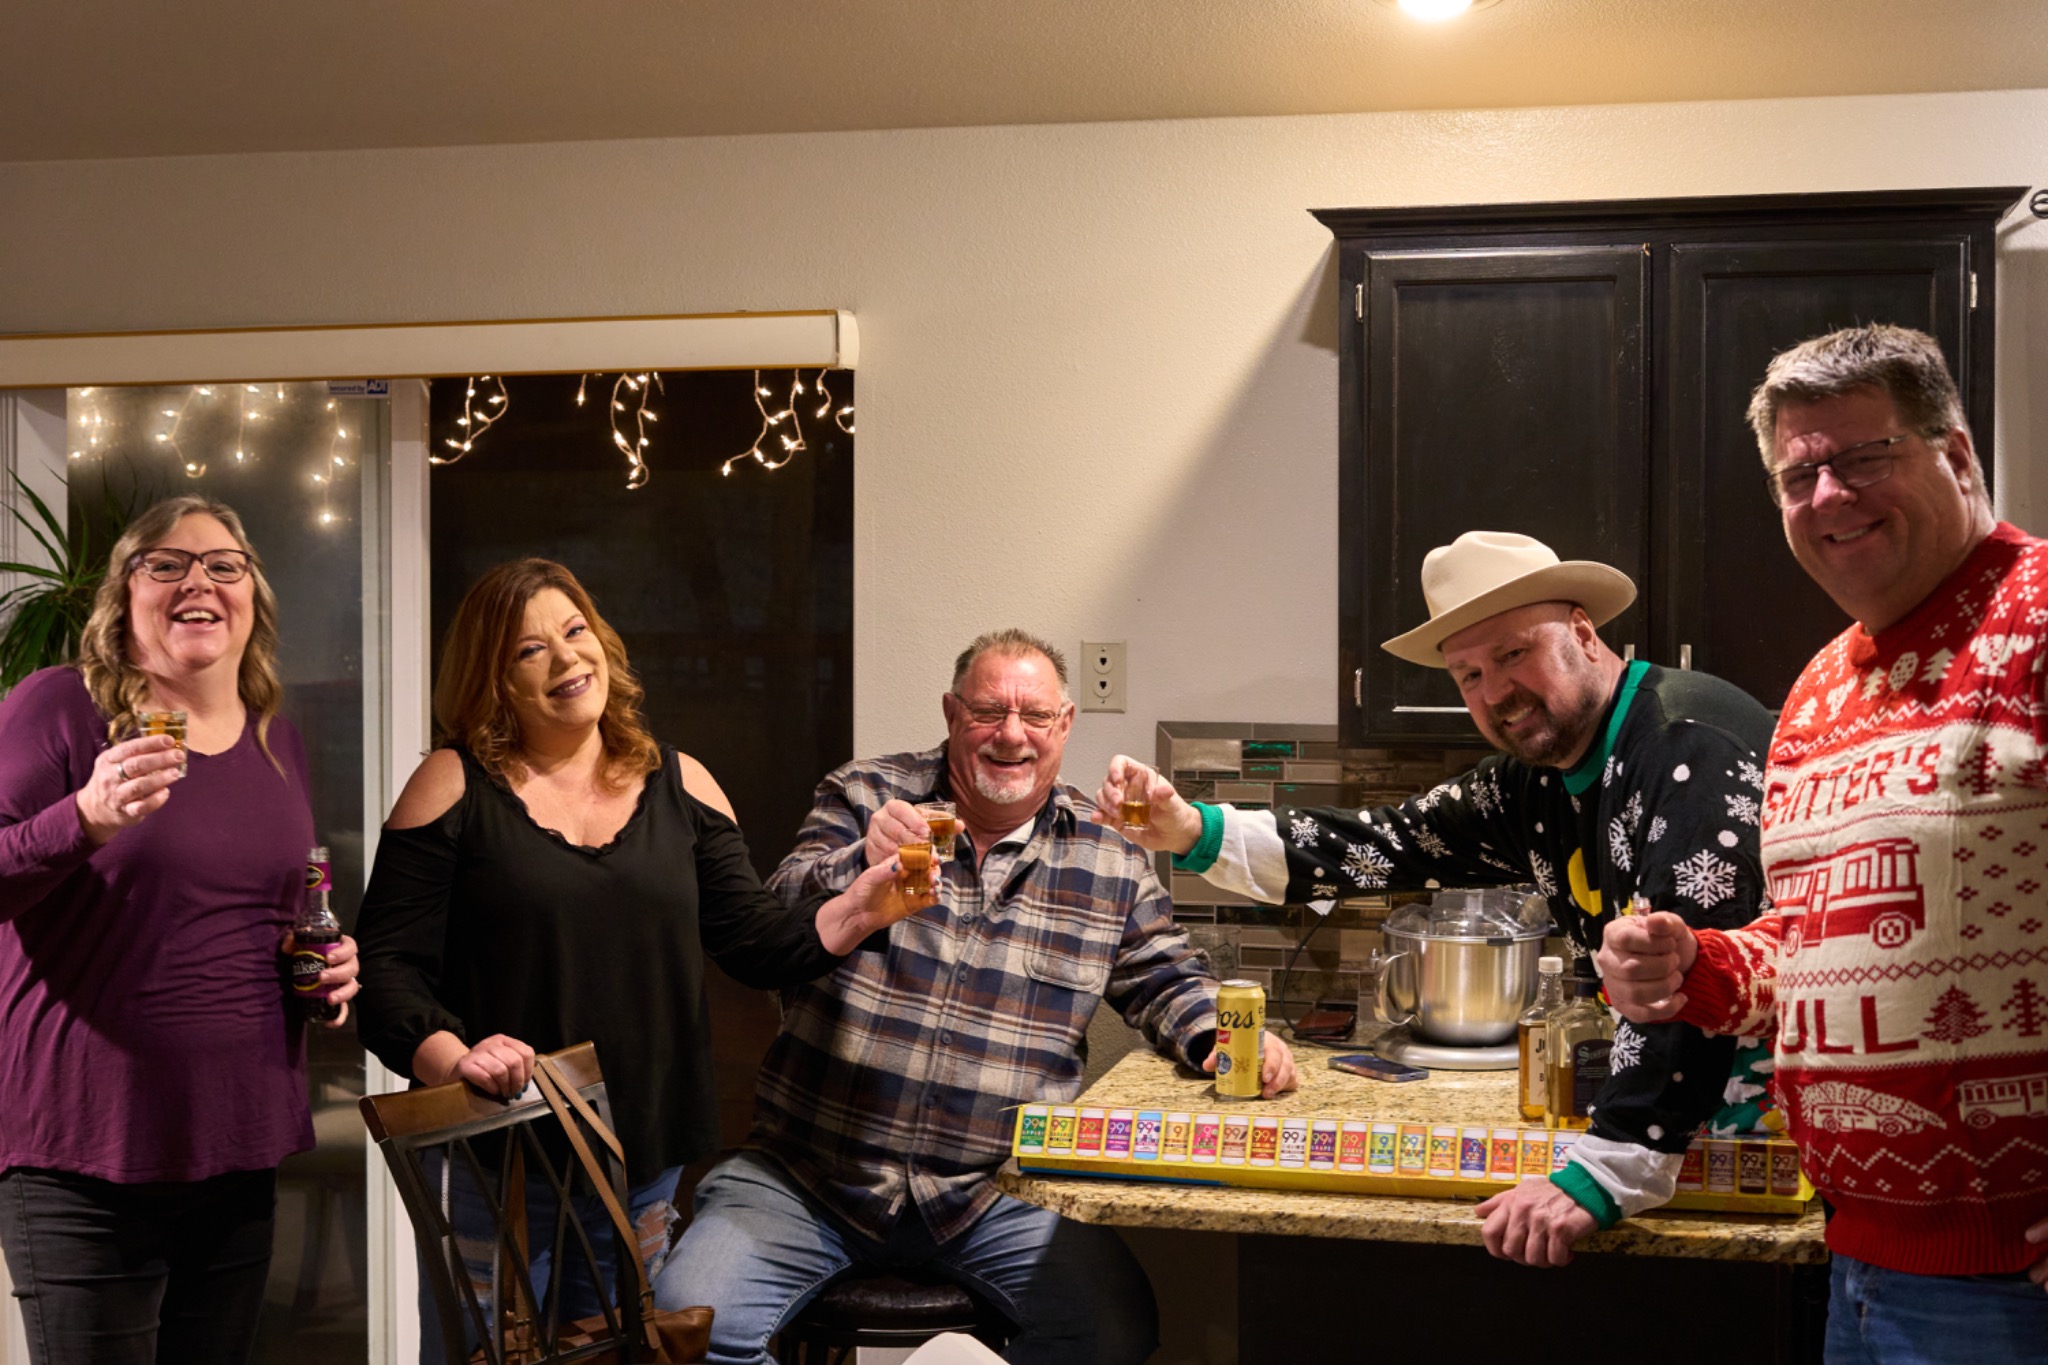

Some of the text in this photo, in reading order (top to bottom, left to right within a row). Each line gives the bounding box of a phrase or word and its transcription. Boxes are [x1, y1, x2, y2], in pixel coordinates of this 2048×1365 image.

[367, 380, 387, 391] ADT
[1761, 744, 1941, 831] SHITTER'S
[292, 959, 325, 976] ike's
[1216, 1010, 1256, 1029] ors
[1776, 996, 1919, 1055] ULL
[1023, 1118, 1039, 1130] 99
[1051, 1119, 1068, 1131] 99
[1080, 1120, 1097, 1132] 99
[1109, 1122, 1125, 1134] 99
[1137, 1121, 1153, 1134] 99
[1224, 1127, 1240, 1139] 99
[1253, 1130, 1270, 1142] 99
[1282, 1131, 1299, 1143] 99
[1312, 1133, 1328, 1145] 99
[1342, 1134, 1358, 1147] 99
[1400, 1135, 1418, 1149] 99
[1431, 1139, 1449, 1152] 99
[1708, 1153, 1727, 1167] 99
[1740, 1153, 1759, 1167] 99
[1772, 1155, 1790, 1169] 99
